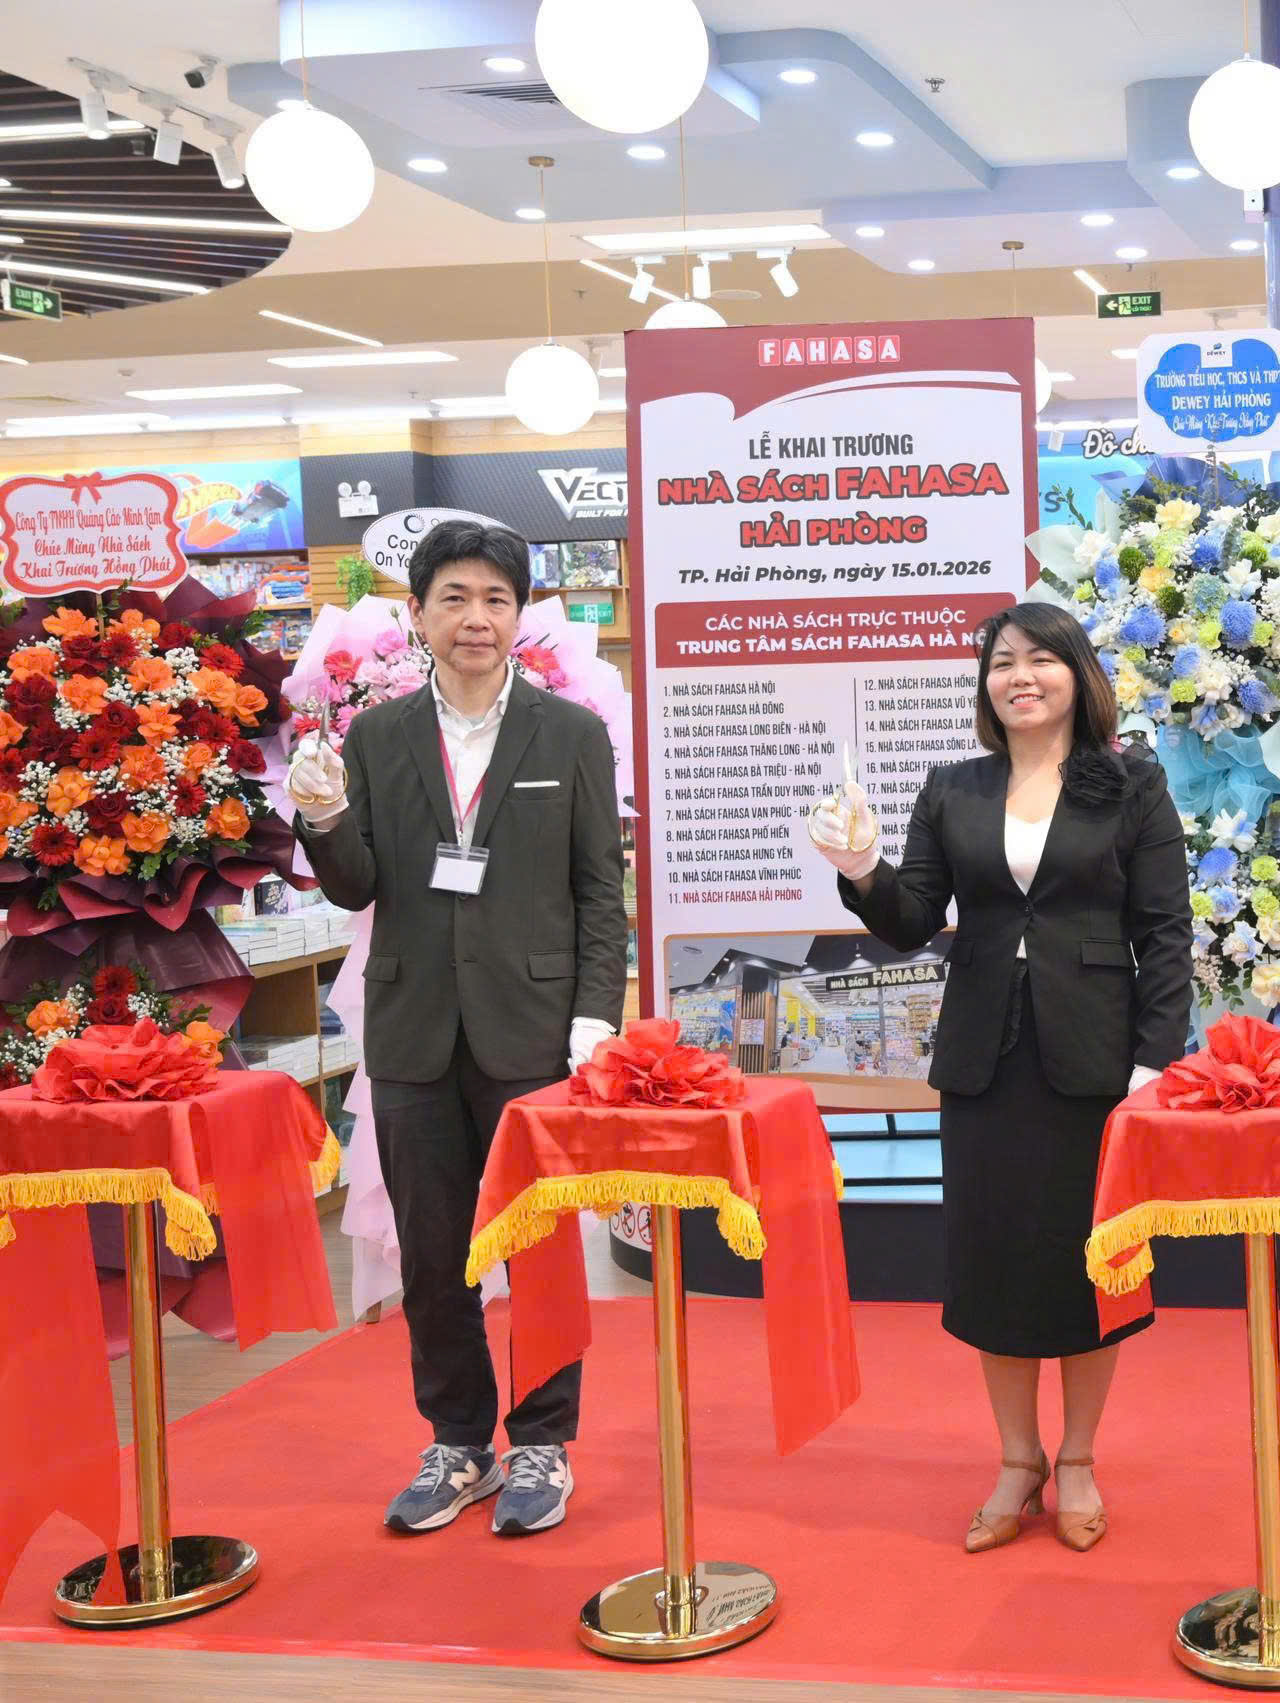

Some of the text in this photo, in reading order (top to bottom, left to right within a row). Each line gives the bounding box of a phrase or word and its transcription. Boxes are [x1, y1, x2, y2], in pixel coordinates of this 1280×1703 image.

[1132, 296, 1152, 304] EXIT
[762, 337, 899, 364] FAHASA
[1155, 371, 1186, 388] TRƯỜNG
[1227, 372, 1247, 384] THCS
[1250, 367, 1261, 384] VÀ
[1172, 390, 1271, 410] DEWEY HẢI PHÒNG
[749, 430, 914, 461] LỄ KHAI TRƯƠNG
[1082, 428, 1118, 459] Đồ
[658, 462, 1009, 505] NHÀ SÁCH FAHASA
[15, 512, 35, 536] Công
[37, 511, 48, 534] Ty
[50, 510, 75, 529] TNHH
[78, 509, 104, 532] Quảng
[123, 507, 143, 526] Minh
[576, 509, 622, 518] BUILT FOR
[740, 511, 927, 548] HẢI PHÒNG
[34, 534, 151, 557] Chúc Mừng Nhà Sách
[21, 562, 52, 579] Khai
[102, 557, 136, 577] Hồng
[139, 556, 171, 576] Phát
[375, 551, 393, 566] On
[679, 560, 991, 584] TP. Hải Phòng, ngày 15.01.2026
[705, 608, 966, 631] CÁC NHÀ SÁCH TRỰC THUỘC
[676, 640, 741, 655] TRUNG
[746, 635, 786, 652] TÂM
[791, 634, 842, 651] SÁCH
[847, 633, 925, 649] FAHASA
[929, 629, 957, 647] HÀ
[664, 680, 775, 696] 1. NHÀ SÁCH FAHASA HÀ NỘI
[664, 720, 826, 738] 3. NHÀ SÁCH FAHASA LONG BIÊN HÀ NỘI
[865, 717, 972, 732] 14. NHÀ SÁCH FAHASA LAM
[665, 762, 821, 779] 5. NHÀ SÁCH FAHASA BÀ TRIỆU HÀ NỘI
[667, 848, 793, 862] 9. NHÀ SÁCH FAHASA HƯNG YÊN
[669, 888, 802, 904] 11. NHÀ SÁCH FAHASA HẢI PHÒNG
[830, 966, 938, 989] NHÀ SÁCH FAHASA
